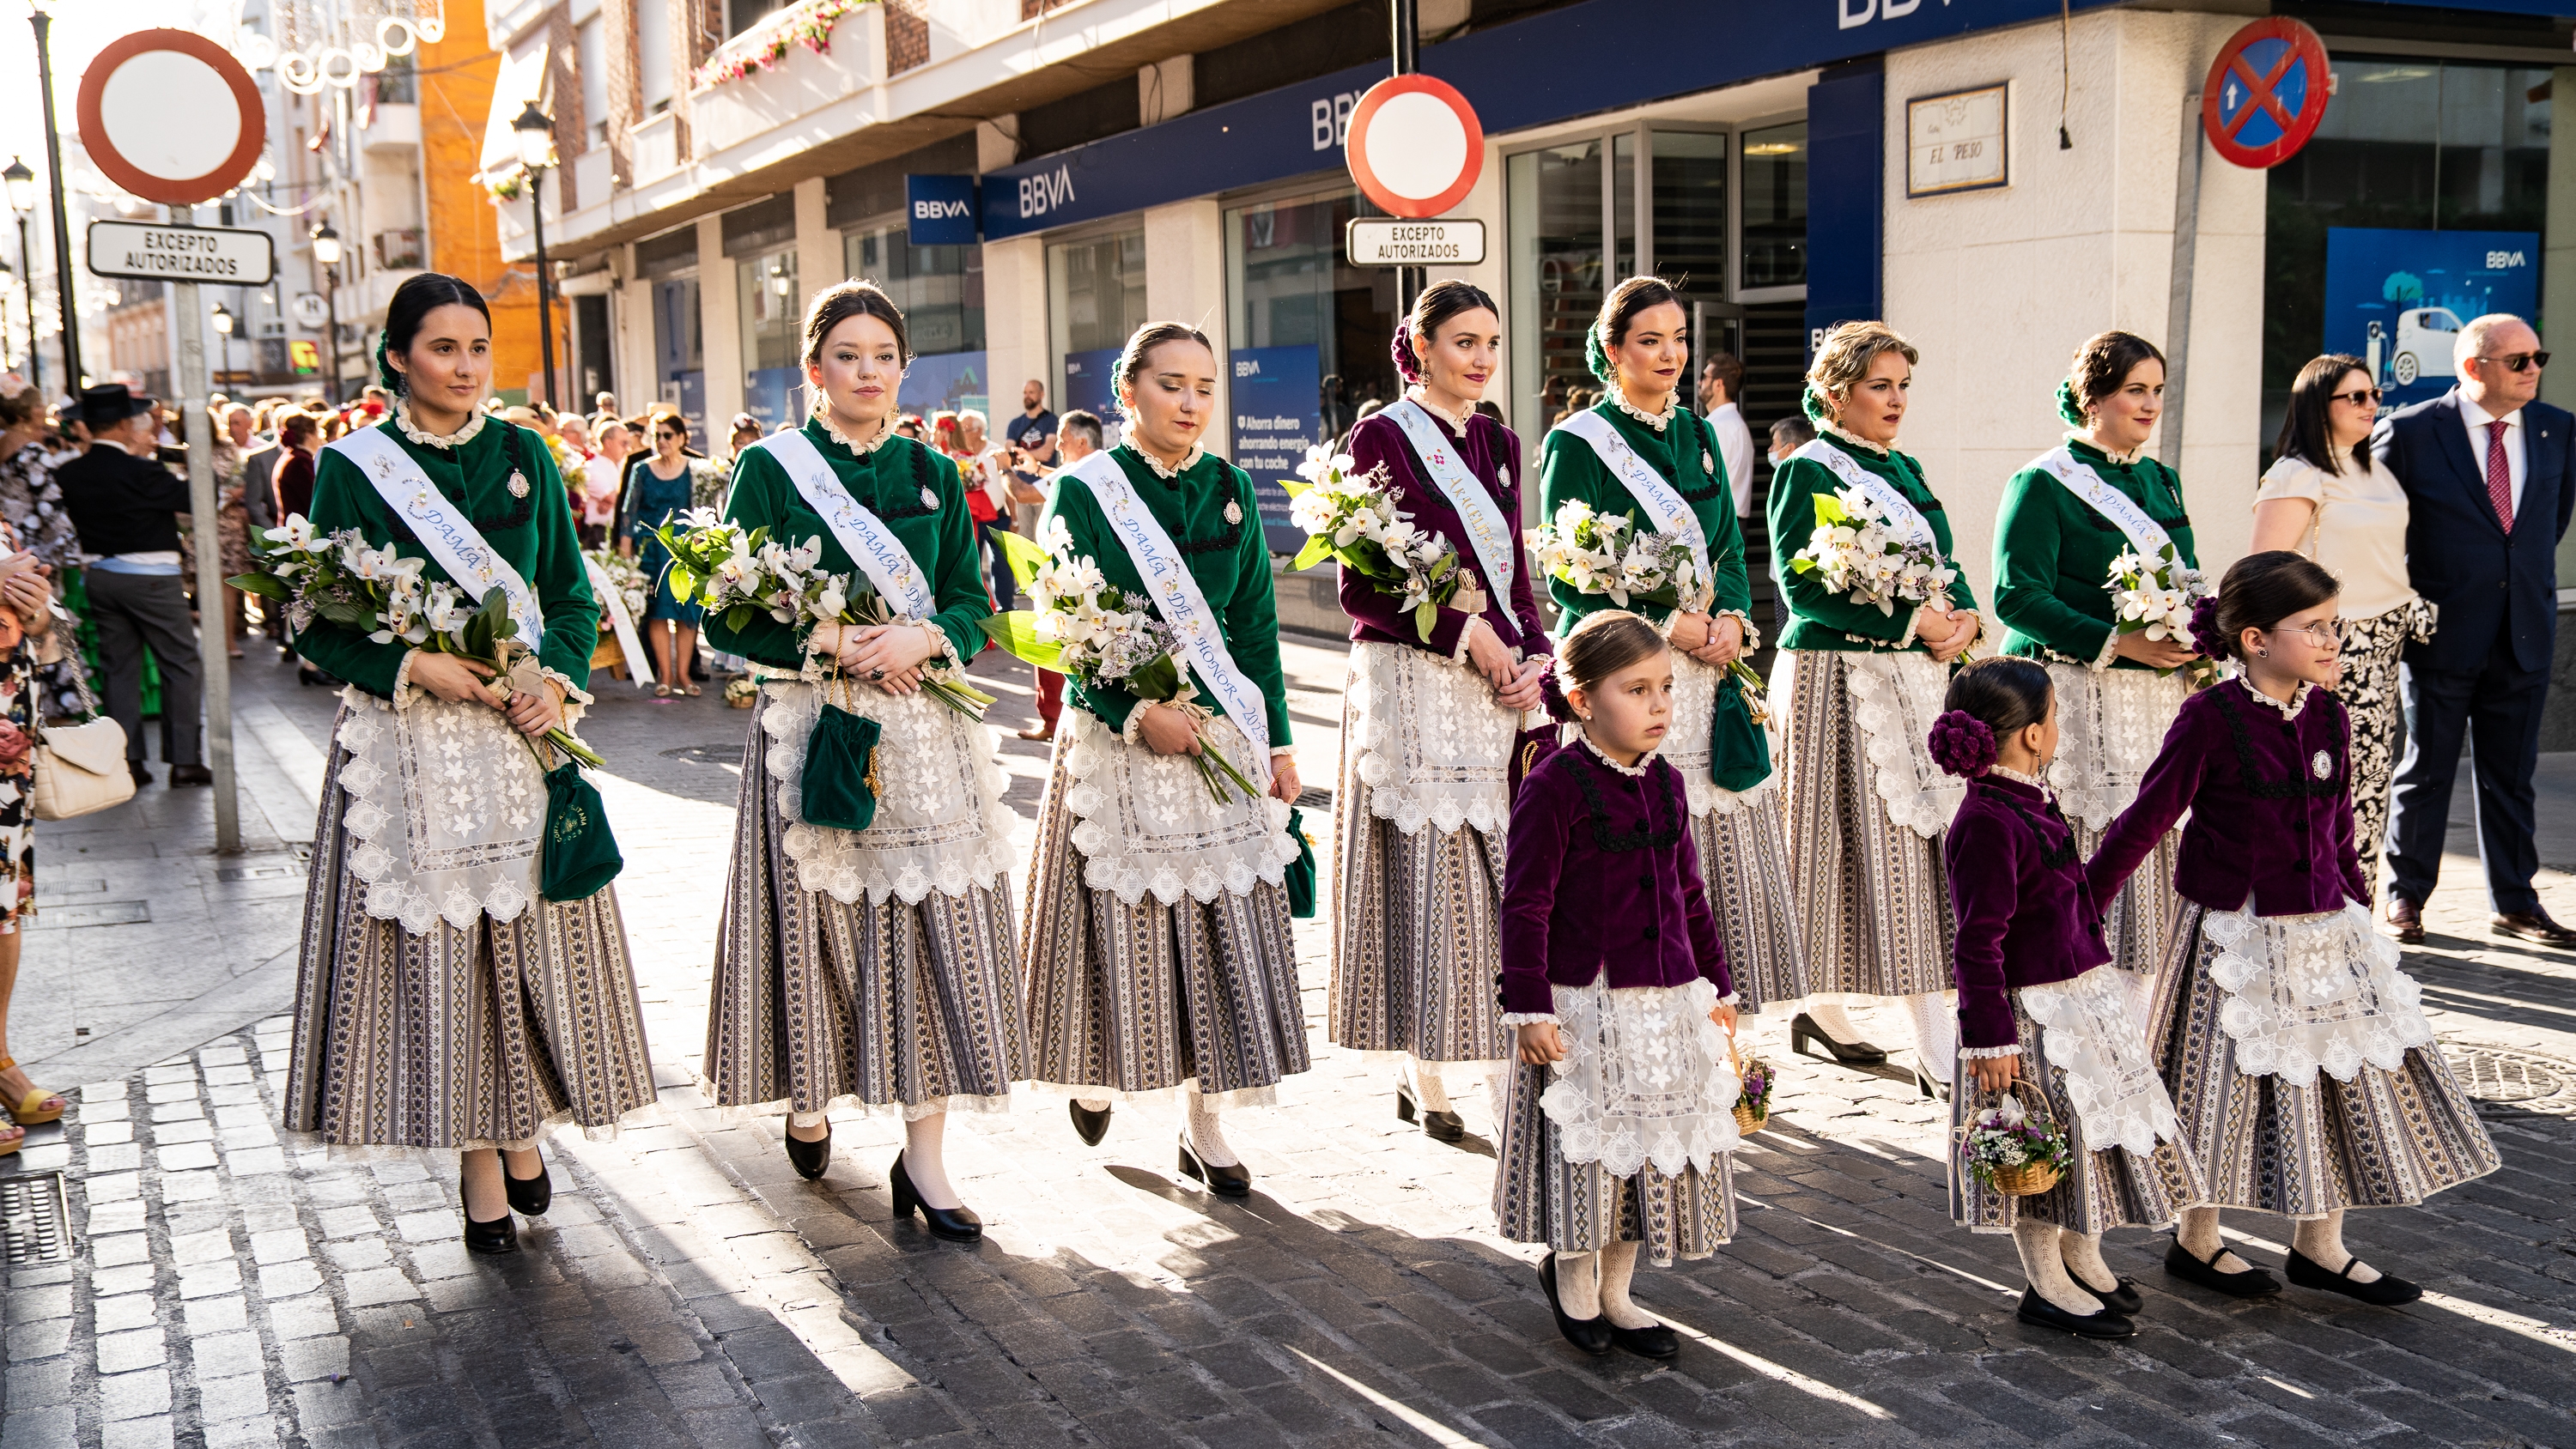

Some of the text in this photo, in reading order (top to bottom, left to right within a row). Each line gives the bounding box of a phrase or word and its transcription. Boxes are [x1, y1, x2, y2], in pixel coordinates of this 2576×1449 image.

[1929, 140, 1983, 165] EL PESO
[1019, 163, 1075, 218] BBVA
[914, 199, 969, 219] BBVA
[145, 232, 217, 252] EXCEPTO
[1392, 227, 1444, 241] EXCEPTO
[1378, 244, 1459, 258] AUTORIZADOS
[2486, 250, 2526, 269] BBVA
[125, 252, 237, 276] AUTORIZADOS
[1236, 360, 1261, 377] BBVA
[1246, 415, 1300, 430] Ahorra dinero
[1238, 434, 1309, 453] ahorrando energía
[1239, 454, 1289, 470] con tu coche
[1633, 470, 1677, 518] DAMA
[1860, 477, 1923, 546] DAMA D
[2103, 494, 2146, 536] DAMA
[422, 509, 482, 570] DAMA
[849, 518, 925, 614] DAMA DE
[1123, 518, 1167, 579] DAMA
[1167, 592, 1194, 620] DE
[1194, 637, 1236, 702] HONOR
[1242, 707, 1265, 742] 2023
